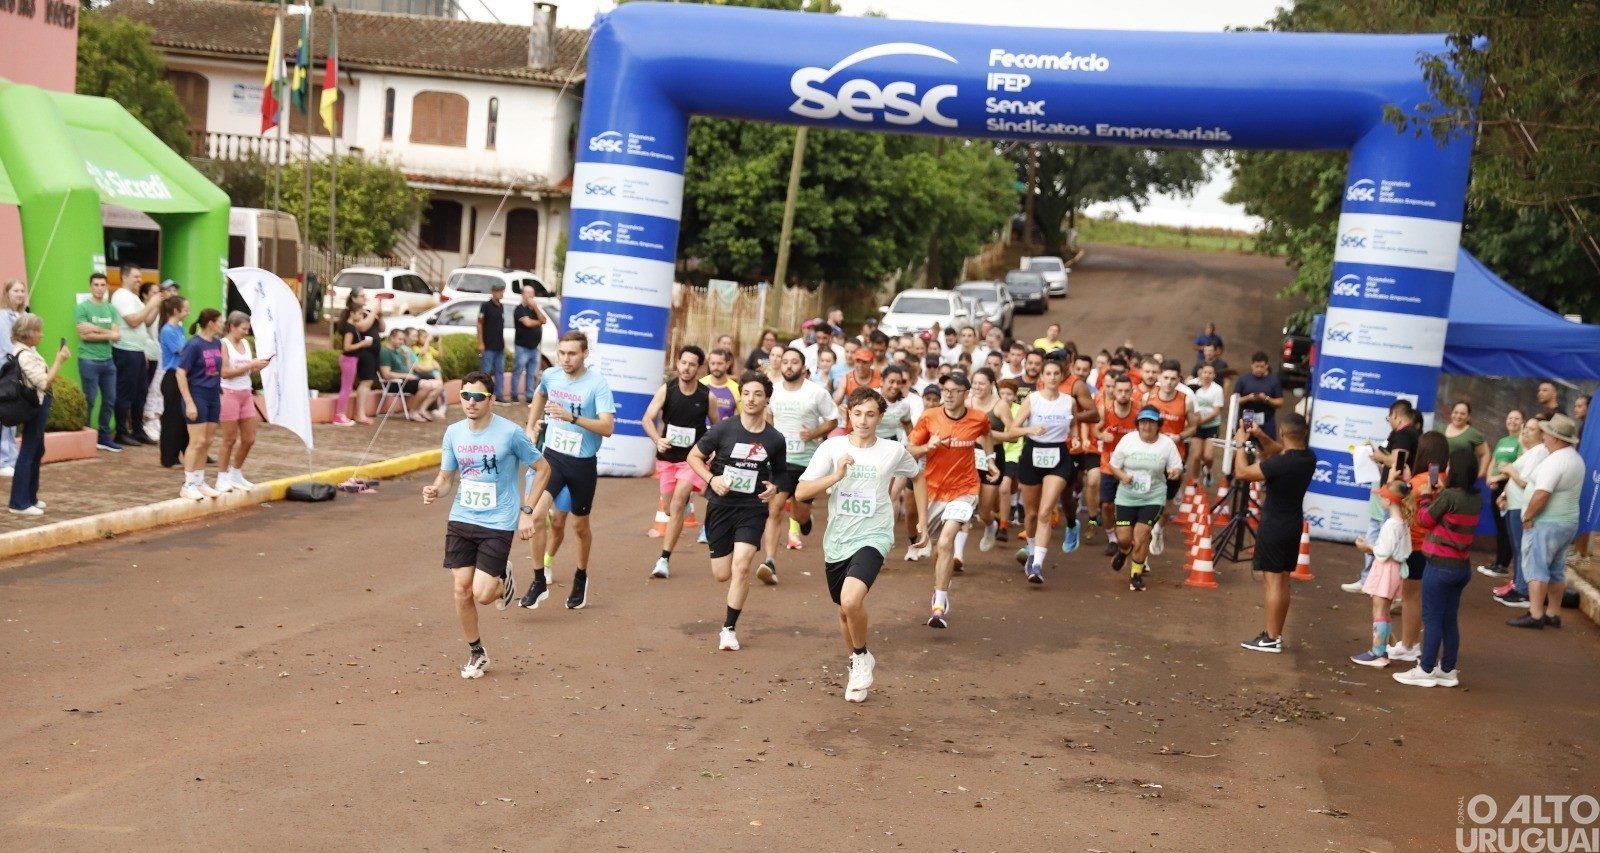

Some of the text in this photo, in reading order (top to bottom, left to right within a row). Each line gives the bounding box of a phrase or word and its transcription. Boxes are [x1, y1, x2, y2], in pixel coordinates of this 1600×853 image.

[988, 48, 1110, 73] Fecomércio
[986, 72, 1032, 93] IFEP
[788, 66, 959, 128] Sesc
[986, 97, 1046, 117] Senac
[986, 118, 1233, 142] Sindicatos Empresariais
[550, 389, 582, 403] CHAPADA
[554, 436, 577, 453] 517
[670, 433, 691, 446] 230
[457, 445, 496, 454] CHAPADA
[1036, 455, 1056, 466] 267
[464, 490, 491, 507] 375
[841, 499, 871, 515] 465
